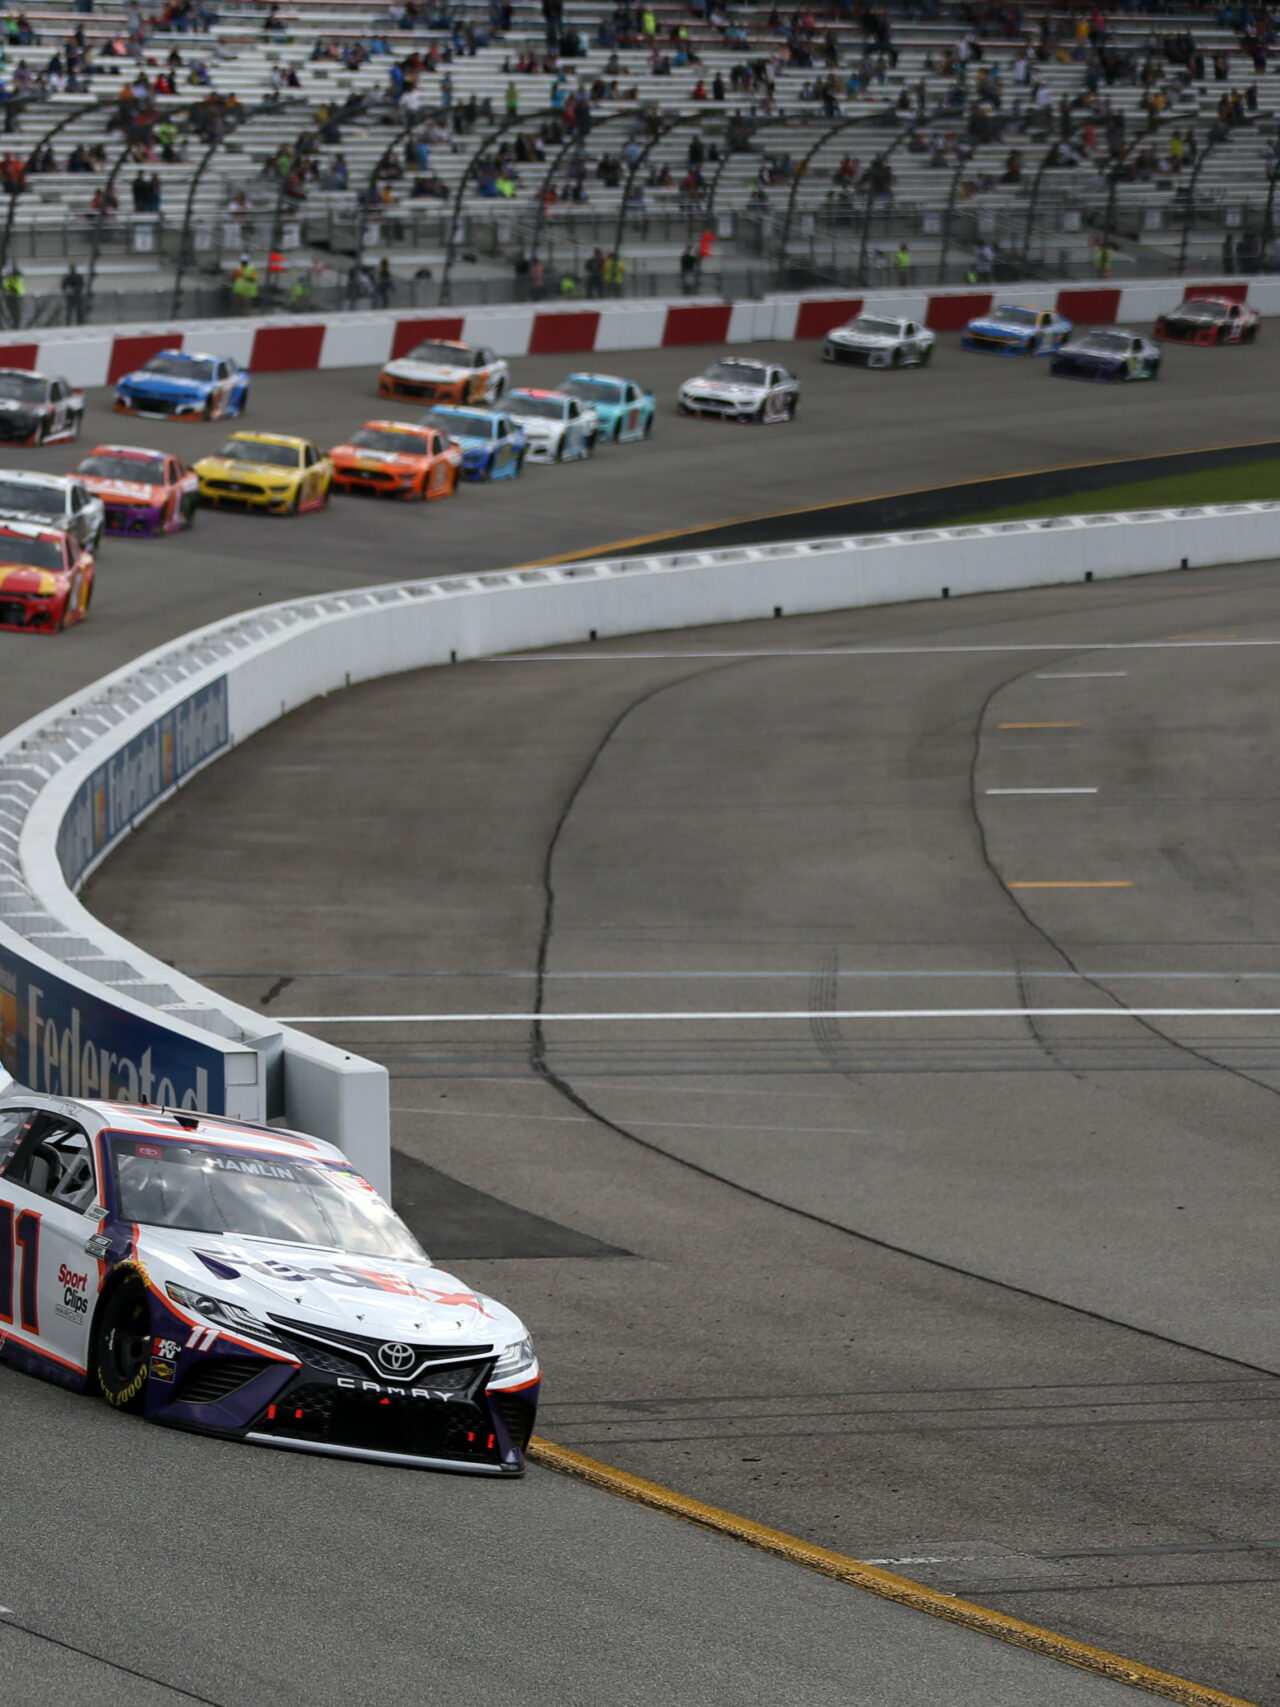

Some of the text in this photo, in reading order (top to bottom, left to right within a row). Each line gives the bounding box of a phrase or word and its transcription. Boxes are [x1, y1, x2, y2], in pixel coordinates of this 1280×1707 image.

[213, 1157, 295, 1180] HAMLIN
[58, 1263, 88, 1292] Sport
[63, 1286, 89, 1314] Clips
[184, 1325, 221, 1353] 11
[336, 1377, 455, 1403] CAMRY
